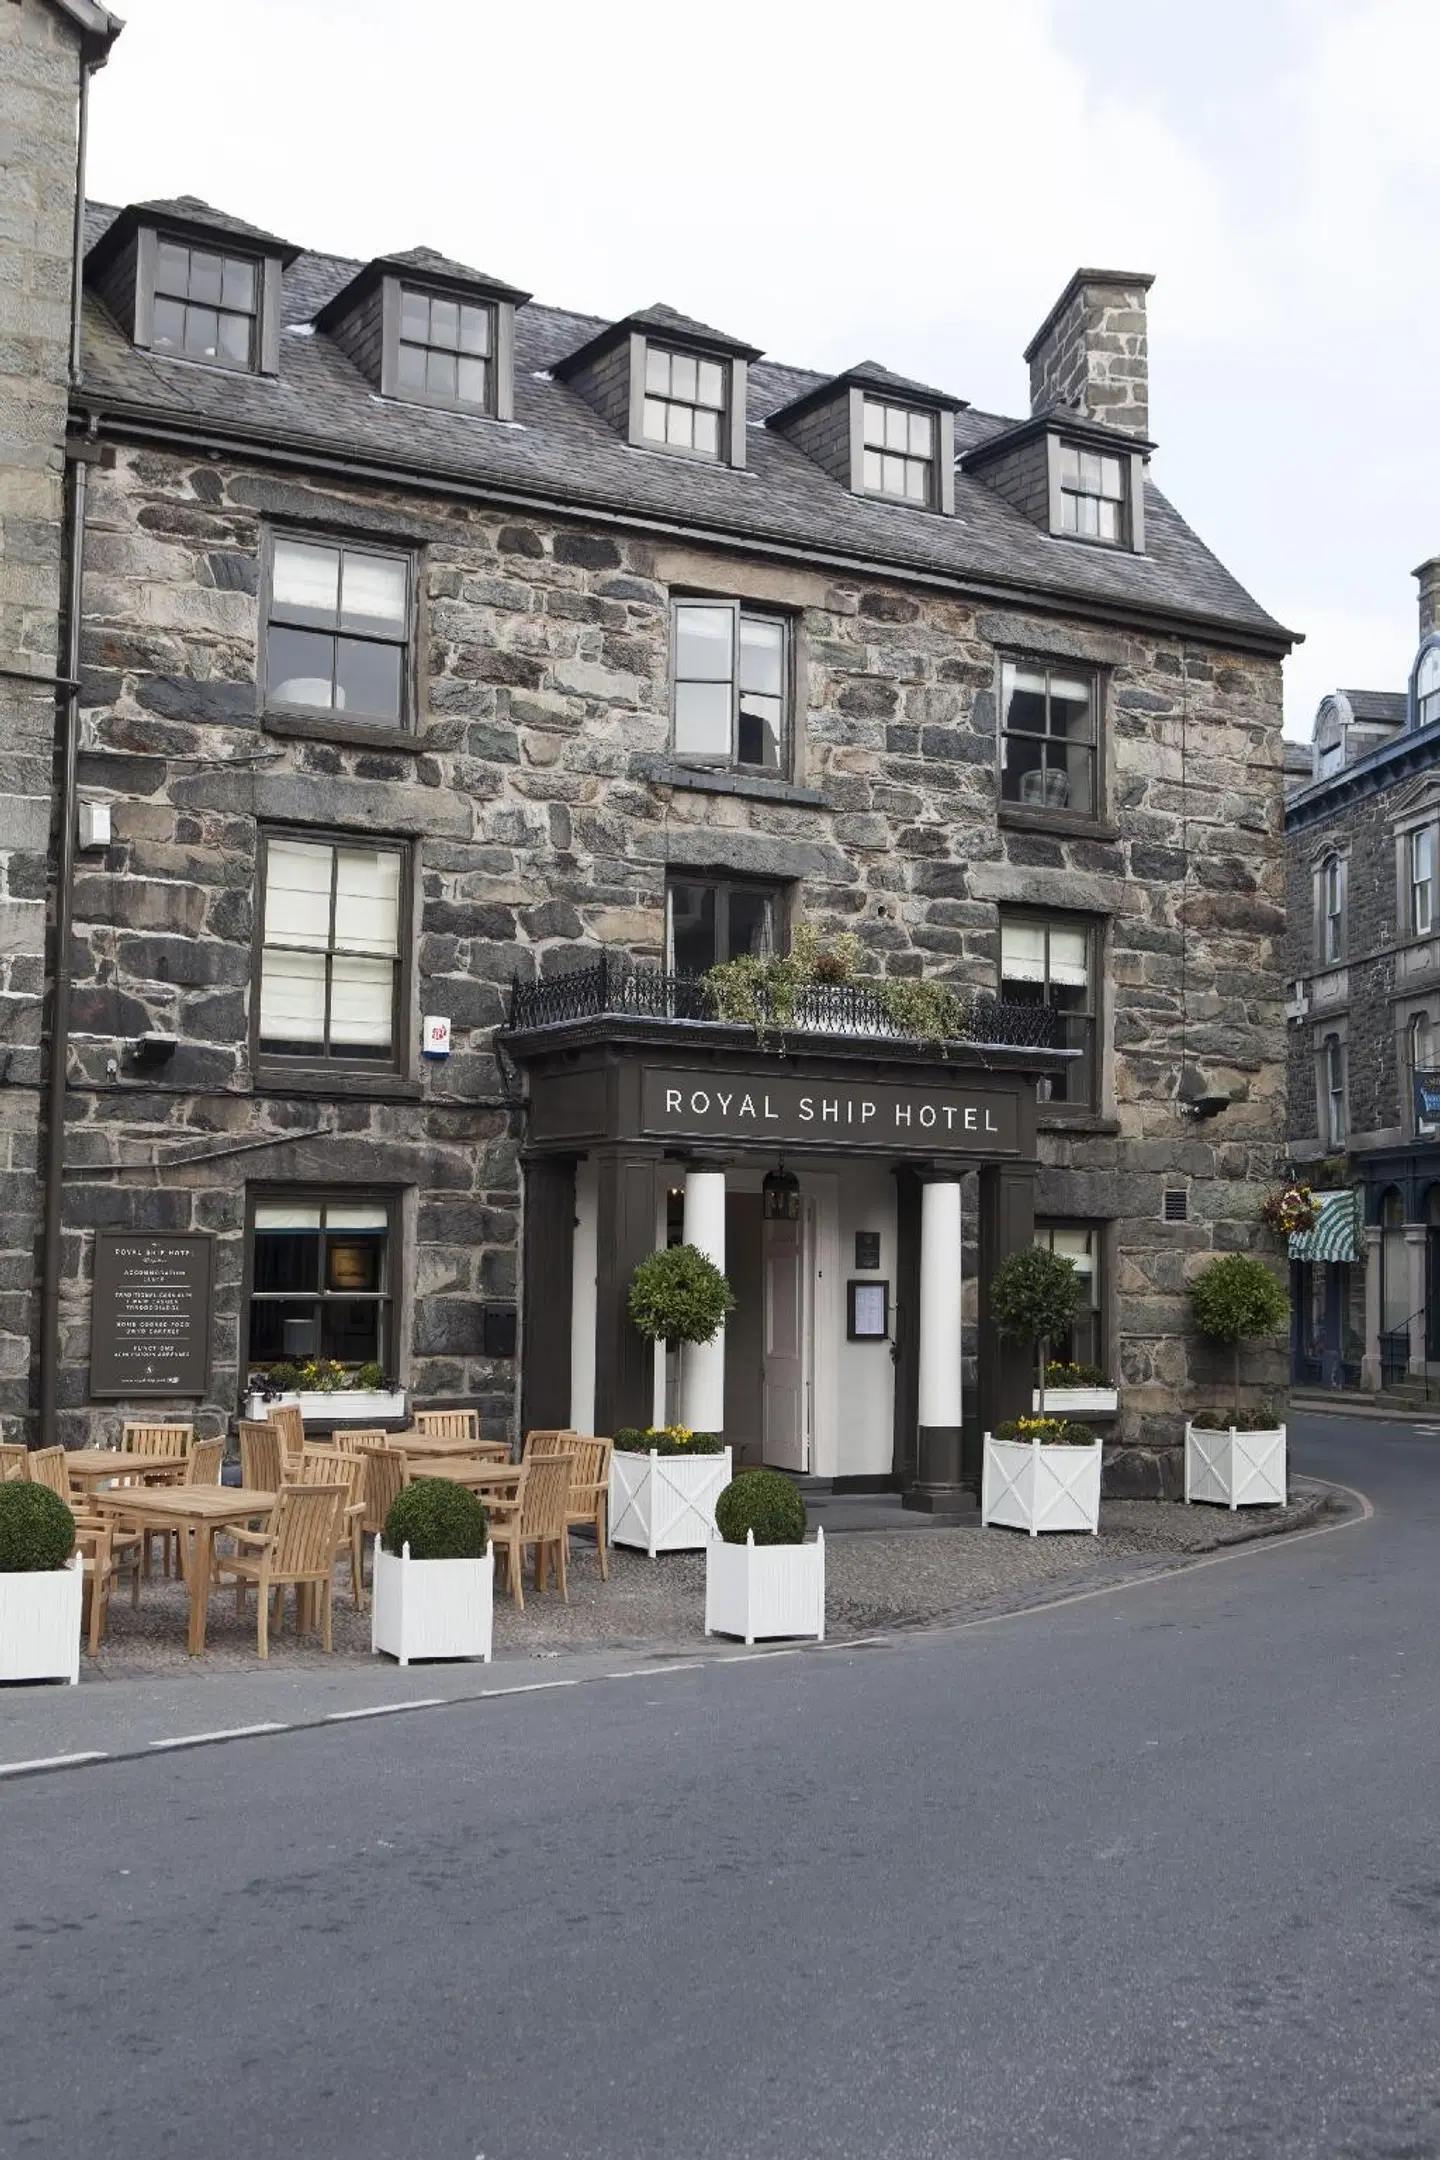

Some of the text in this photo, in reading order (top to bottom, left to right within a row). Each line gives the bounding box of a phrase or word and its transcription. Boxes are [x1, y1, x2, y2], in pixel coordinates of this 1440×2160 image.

[666, 1089, 998, 1132] ROYAL SHIP HOTEL
